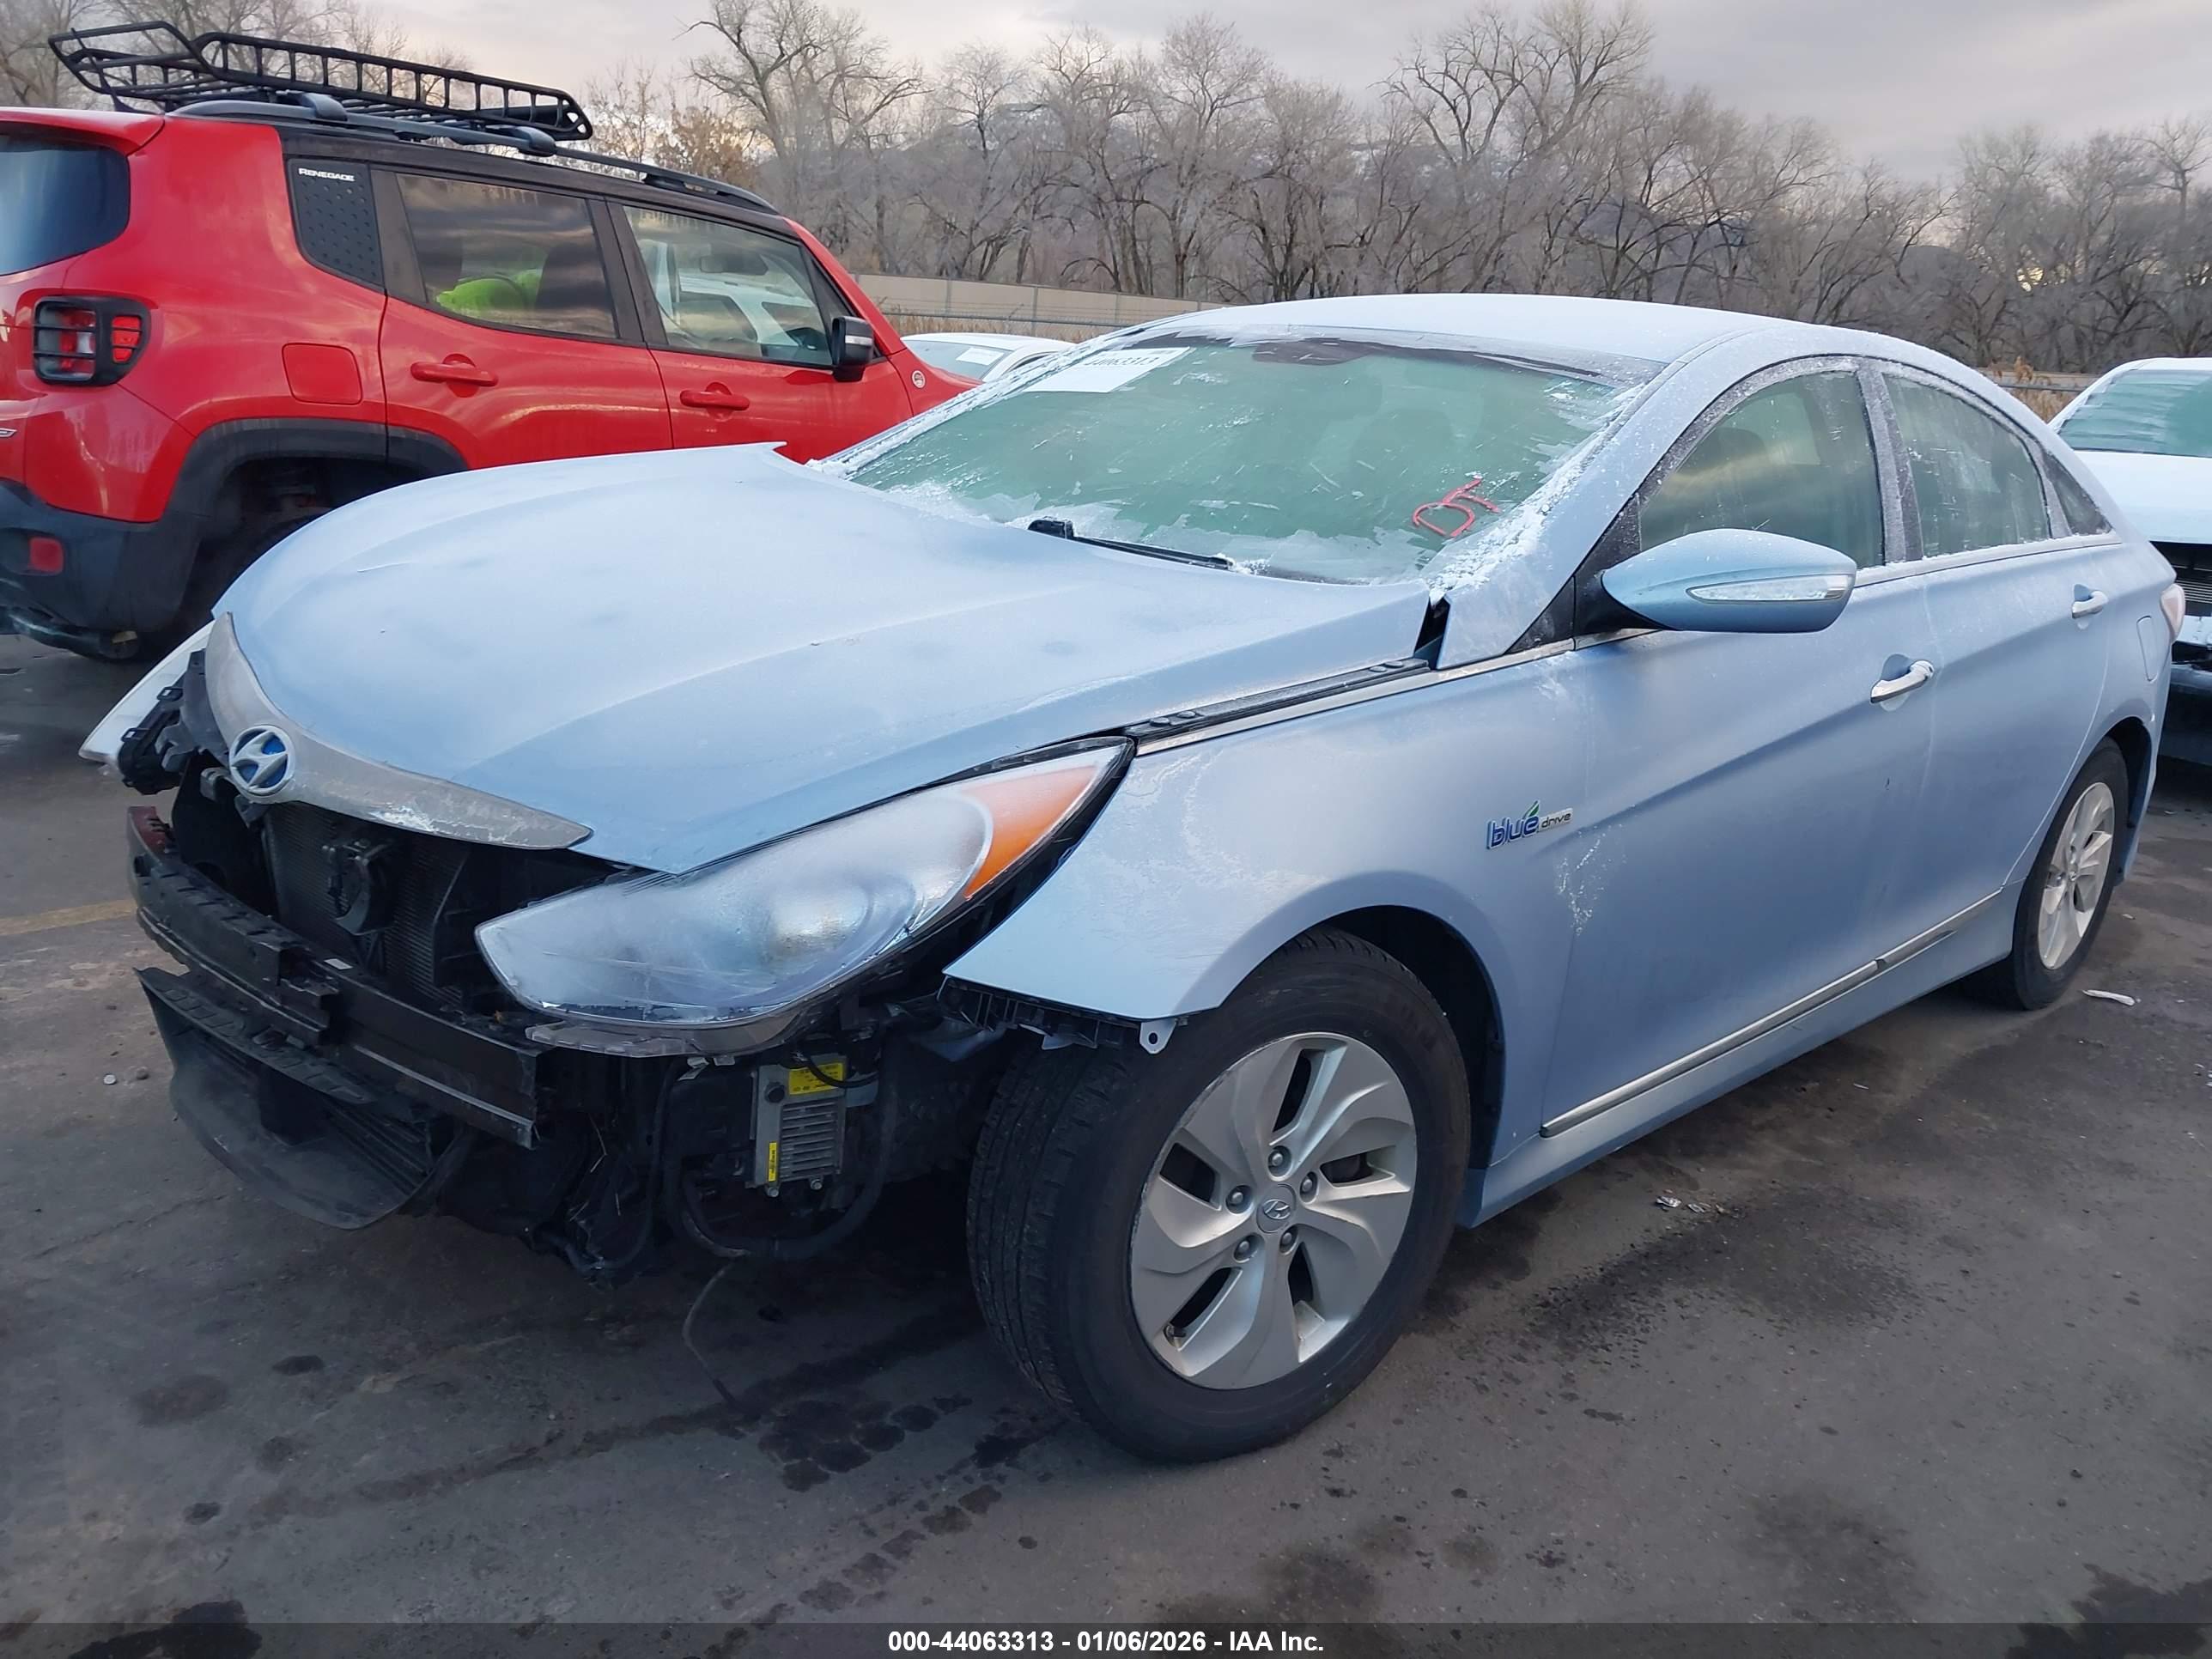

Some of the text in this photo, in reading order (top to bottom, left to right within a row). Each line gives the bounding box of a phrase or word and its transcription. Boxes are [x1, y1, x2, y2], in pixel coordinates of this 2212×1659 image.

[298, 167, 356, 182] RENEGADE
[1486, 811, 1572, 849] blue drive
